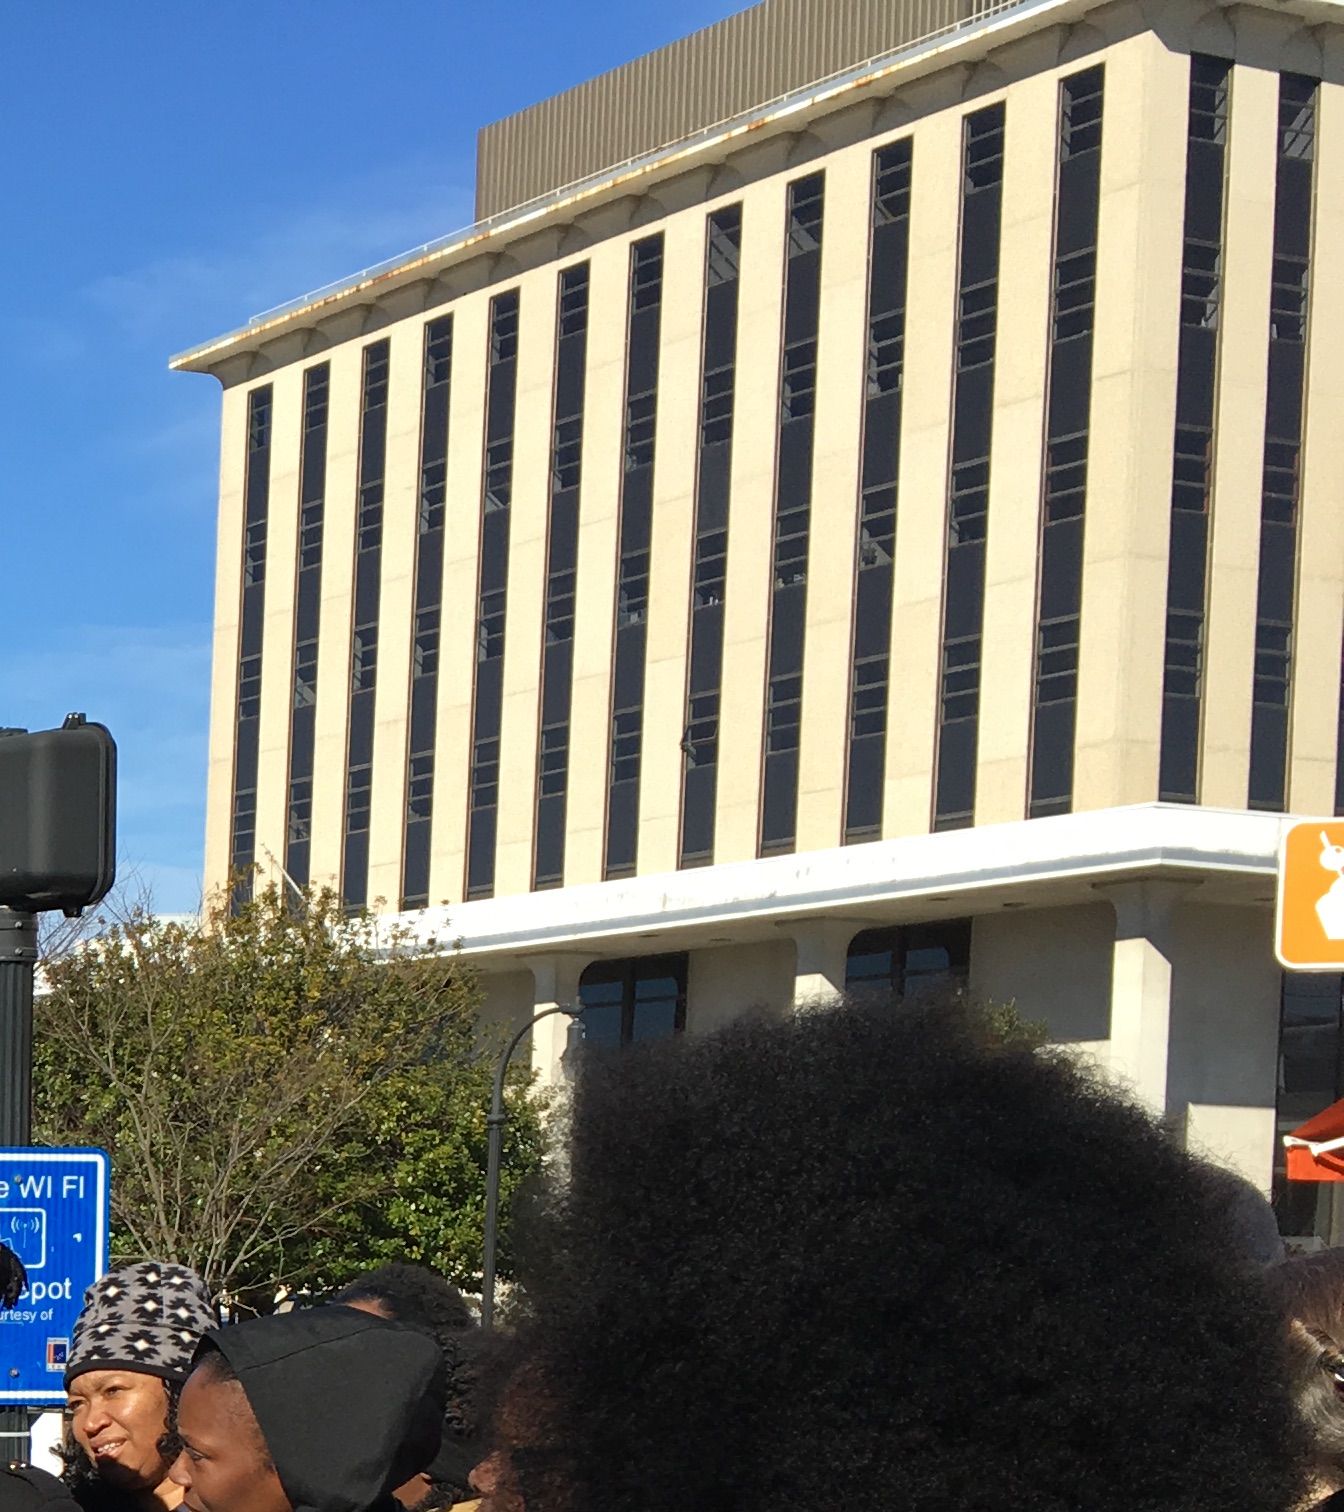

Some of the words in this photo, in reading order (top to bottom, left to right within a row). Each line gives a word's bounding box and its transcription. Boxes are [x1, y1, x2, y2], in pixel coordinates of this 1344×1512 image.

[19, 1175, 53, 1199] WI
[63, 1175, 84, 1199] FI
[40, 1308, 54, 1321] of
